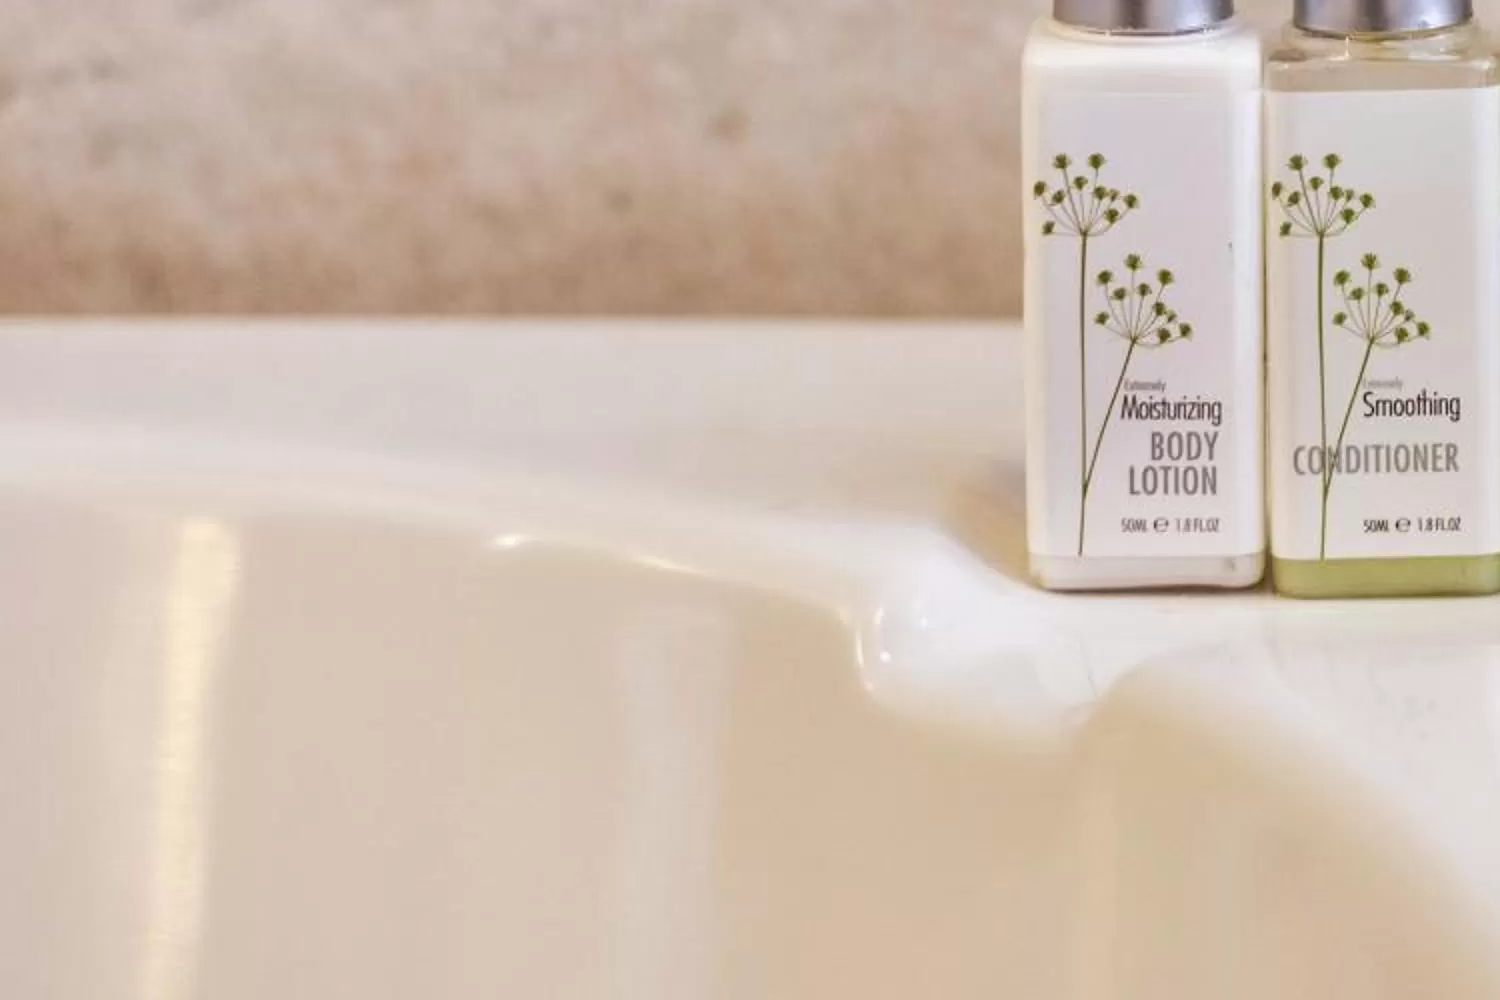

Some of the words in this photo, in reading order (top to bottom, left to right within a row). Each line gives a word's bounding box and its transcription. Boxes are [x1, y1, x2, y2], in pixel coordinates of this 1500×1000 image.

[1120, 394, 1222, 426] Moisturizing
[1363, 388, 1461, 422] Smoothing
[1151, 431, 1219, 461] BODY
[1293, 443, 1460, 475] CONDITIONER
[1129, 466, 1217, 495] LOTION
[1121, 517, 1147, 533] 50ML
[1363, 519, 1389, 533] 50ML
